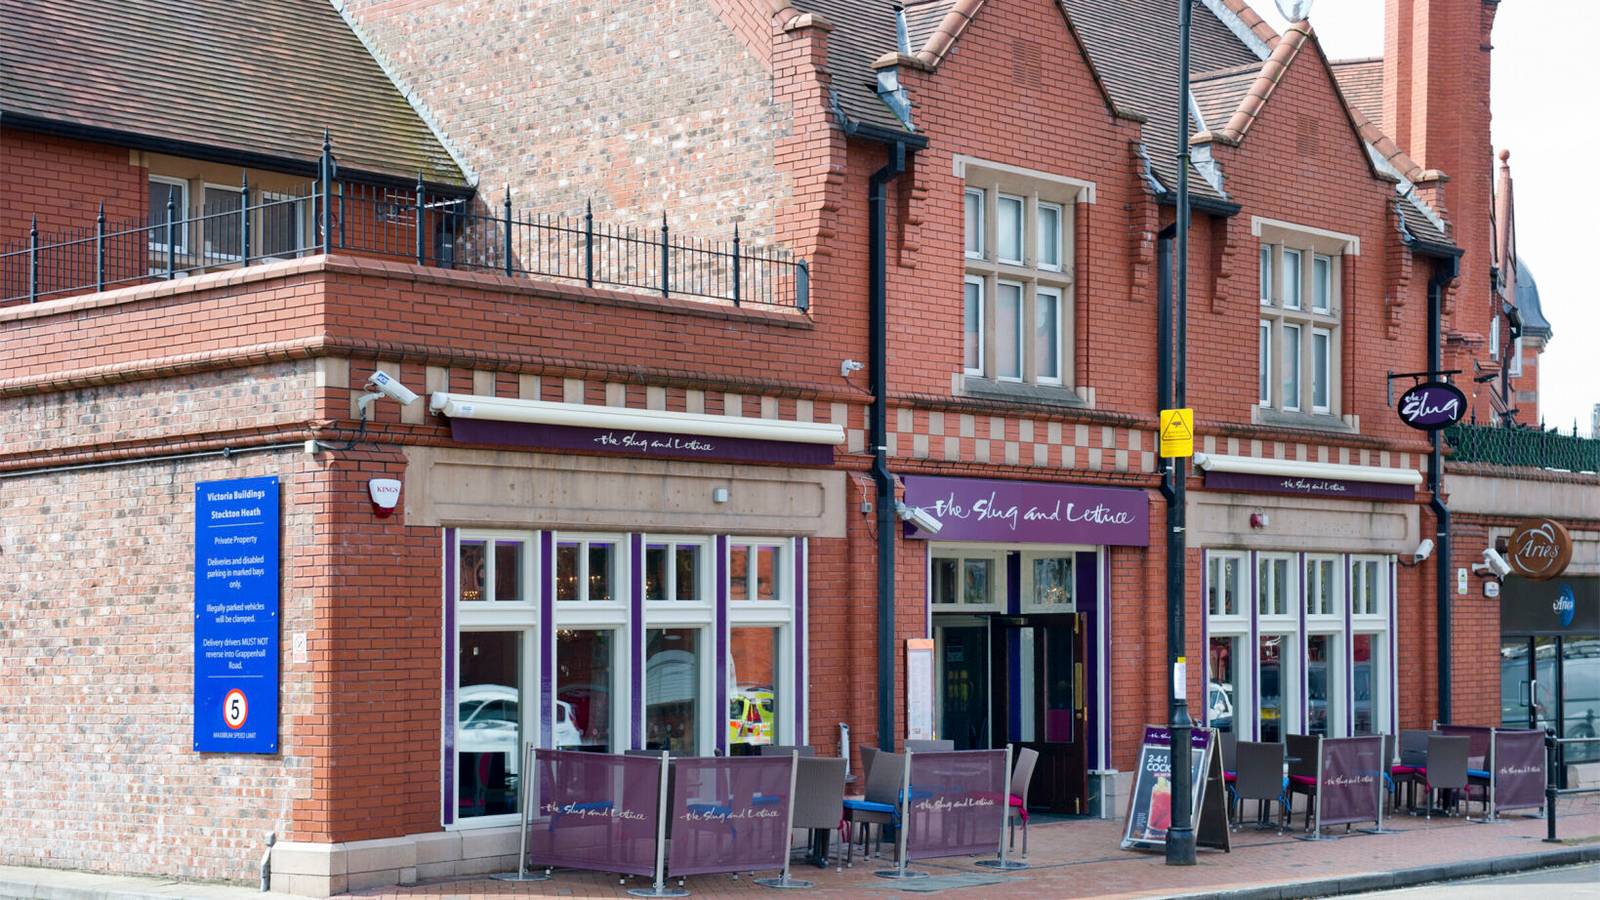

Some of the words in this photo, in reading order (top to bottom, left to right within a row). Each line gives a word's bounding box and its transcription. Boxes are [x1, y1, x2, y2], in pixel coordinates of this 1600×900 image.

[1404, 392, 1423, 403] the
[1402, 392, 1459, 421] Slug
[594, 432, 621, 446] the
[622, 432, 648, 451] Slug
[651, 438, 672, 449] and
[675, 438, 715, 451] Lettuce
[377, 485, 399, 494] KINGS
[1296, 478, 1310, 493] Slug
[207, 491, 233, 502] Victoria
[233, 489, 266, 500] Buildings
[211, 509, 240, 520] Stockton
[240, 507, 261, 518] Heath
[922, 491, 970, 519] the
[972, 491, 1018, 531] Slug
[1023, 500, 1061, 522] and
[1066, 501, 1136, 525] Lettuce
[214, 536, 233, 545] Private
[233, 535, 257, 545] Property
[1518, 539, 1560, 558] Aries
[207, 557, 231, 567] Deliveries
[232, 556, 242, 565] and
[243, 555, 265, 565] disabled
[207, 569, 227, 580] parking
[233, 567, 252, 577] marked
[252, 567, 265, 577] bays
[206, 602, 226, 614] Illegally
[226, 602, 244, 613] parked
[244, 602, 265, 611] vehicles
[215, 614, 225, 624] will
[225, 614, 232, 623] be
[203, 637, 223, 648] Delivery
[224, 638, 241, 647] drivers
[241, 637, 257, 647] MUST
[257, 636, 269, 646] NOT
[205, 650, 224, 659] reverse
[224, 649, 235, 658] into
[235, 648, 267, 660] Grappenhall
[231, 699, 240, 720] 5
[540, 801, 561, 813] the
[564, 801, 586, 819] Slug
[586, 807, 609, 817] and
[680, 808, 703, 821] the
[703, 807, 725, 824] Slug
[726, 808, 745, 819] and
